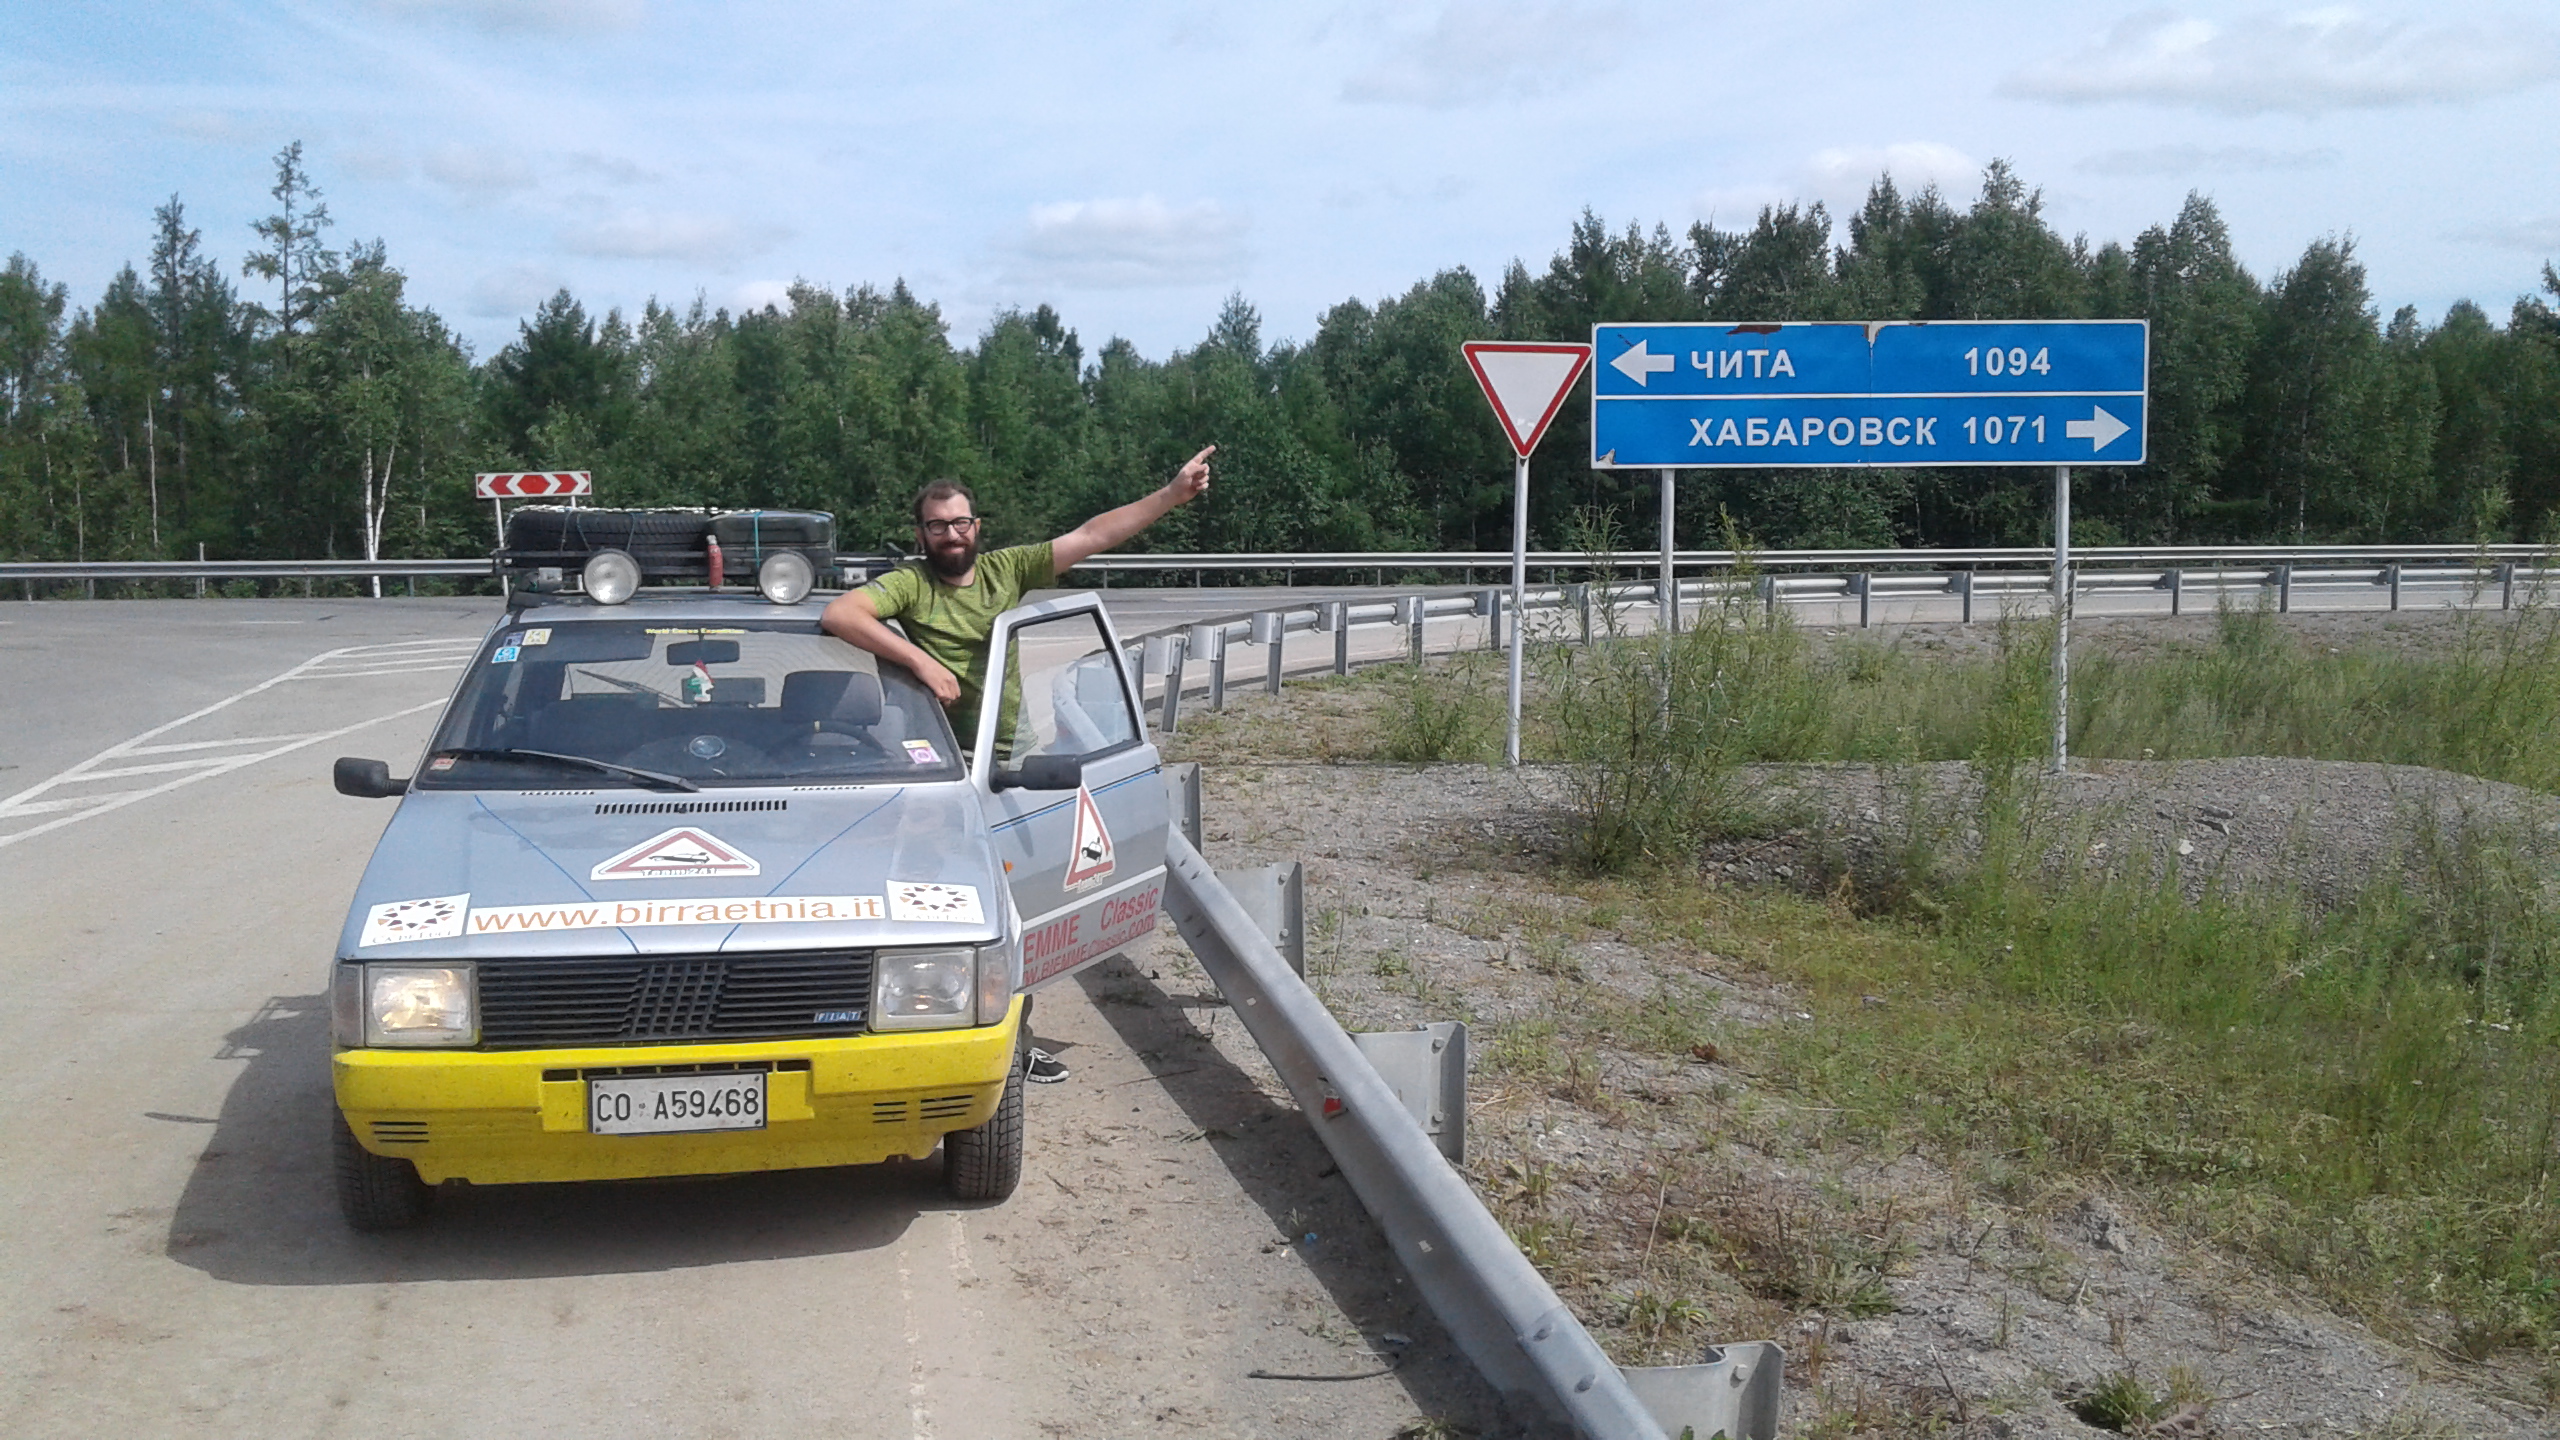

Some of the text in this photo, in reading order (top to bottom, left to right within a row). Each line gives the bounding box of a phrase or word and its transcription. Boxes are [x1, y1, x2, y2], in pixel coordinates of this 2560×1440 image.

[1691, 346, 2052, 379] ЧИТА 1094
[1688, 414, 2046, 447] ХАБАРОВСК 1071
[474, 898, 881, 931] www.birraetnia.it
[1023, 914, 1081, 965] EMME
[1100, 883, 1159, 931] Classic
[818, 1011, 859, 1021] FIAT
[597, 1087, 759, 1122] CO A59468
